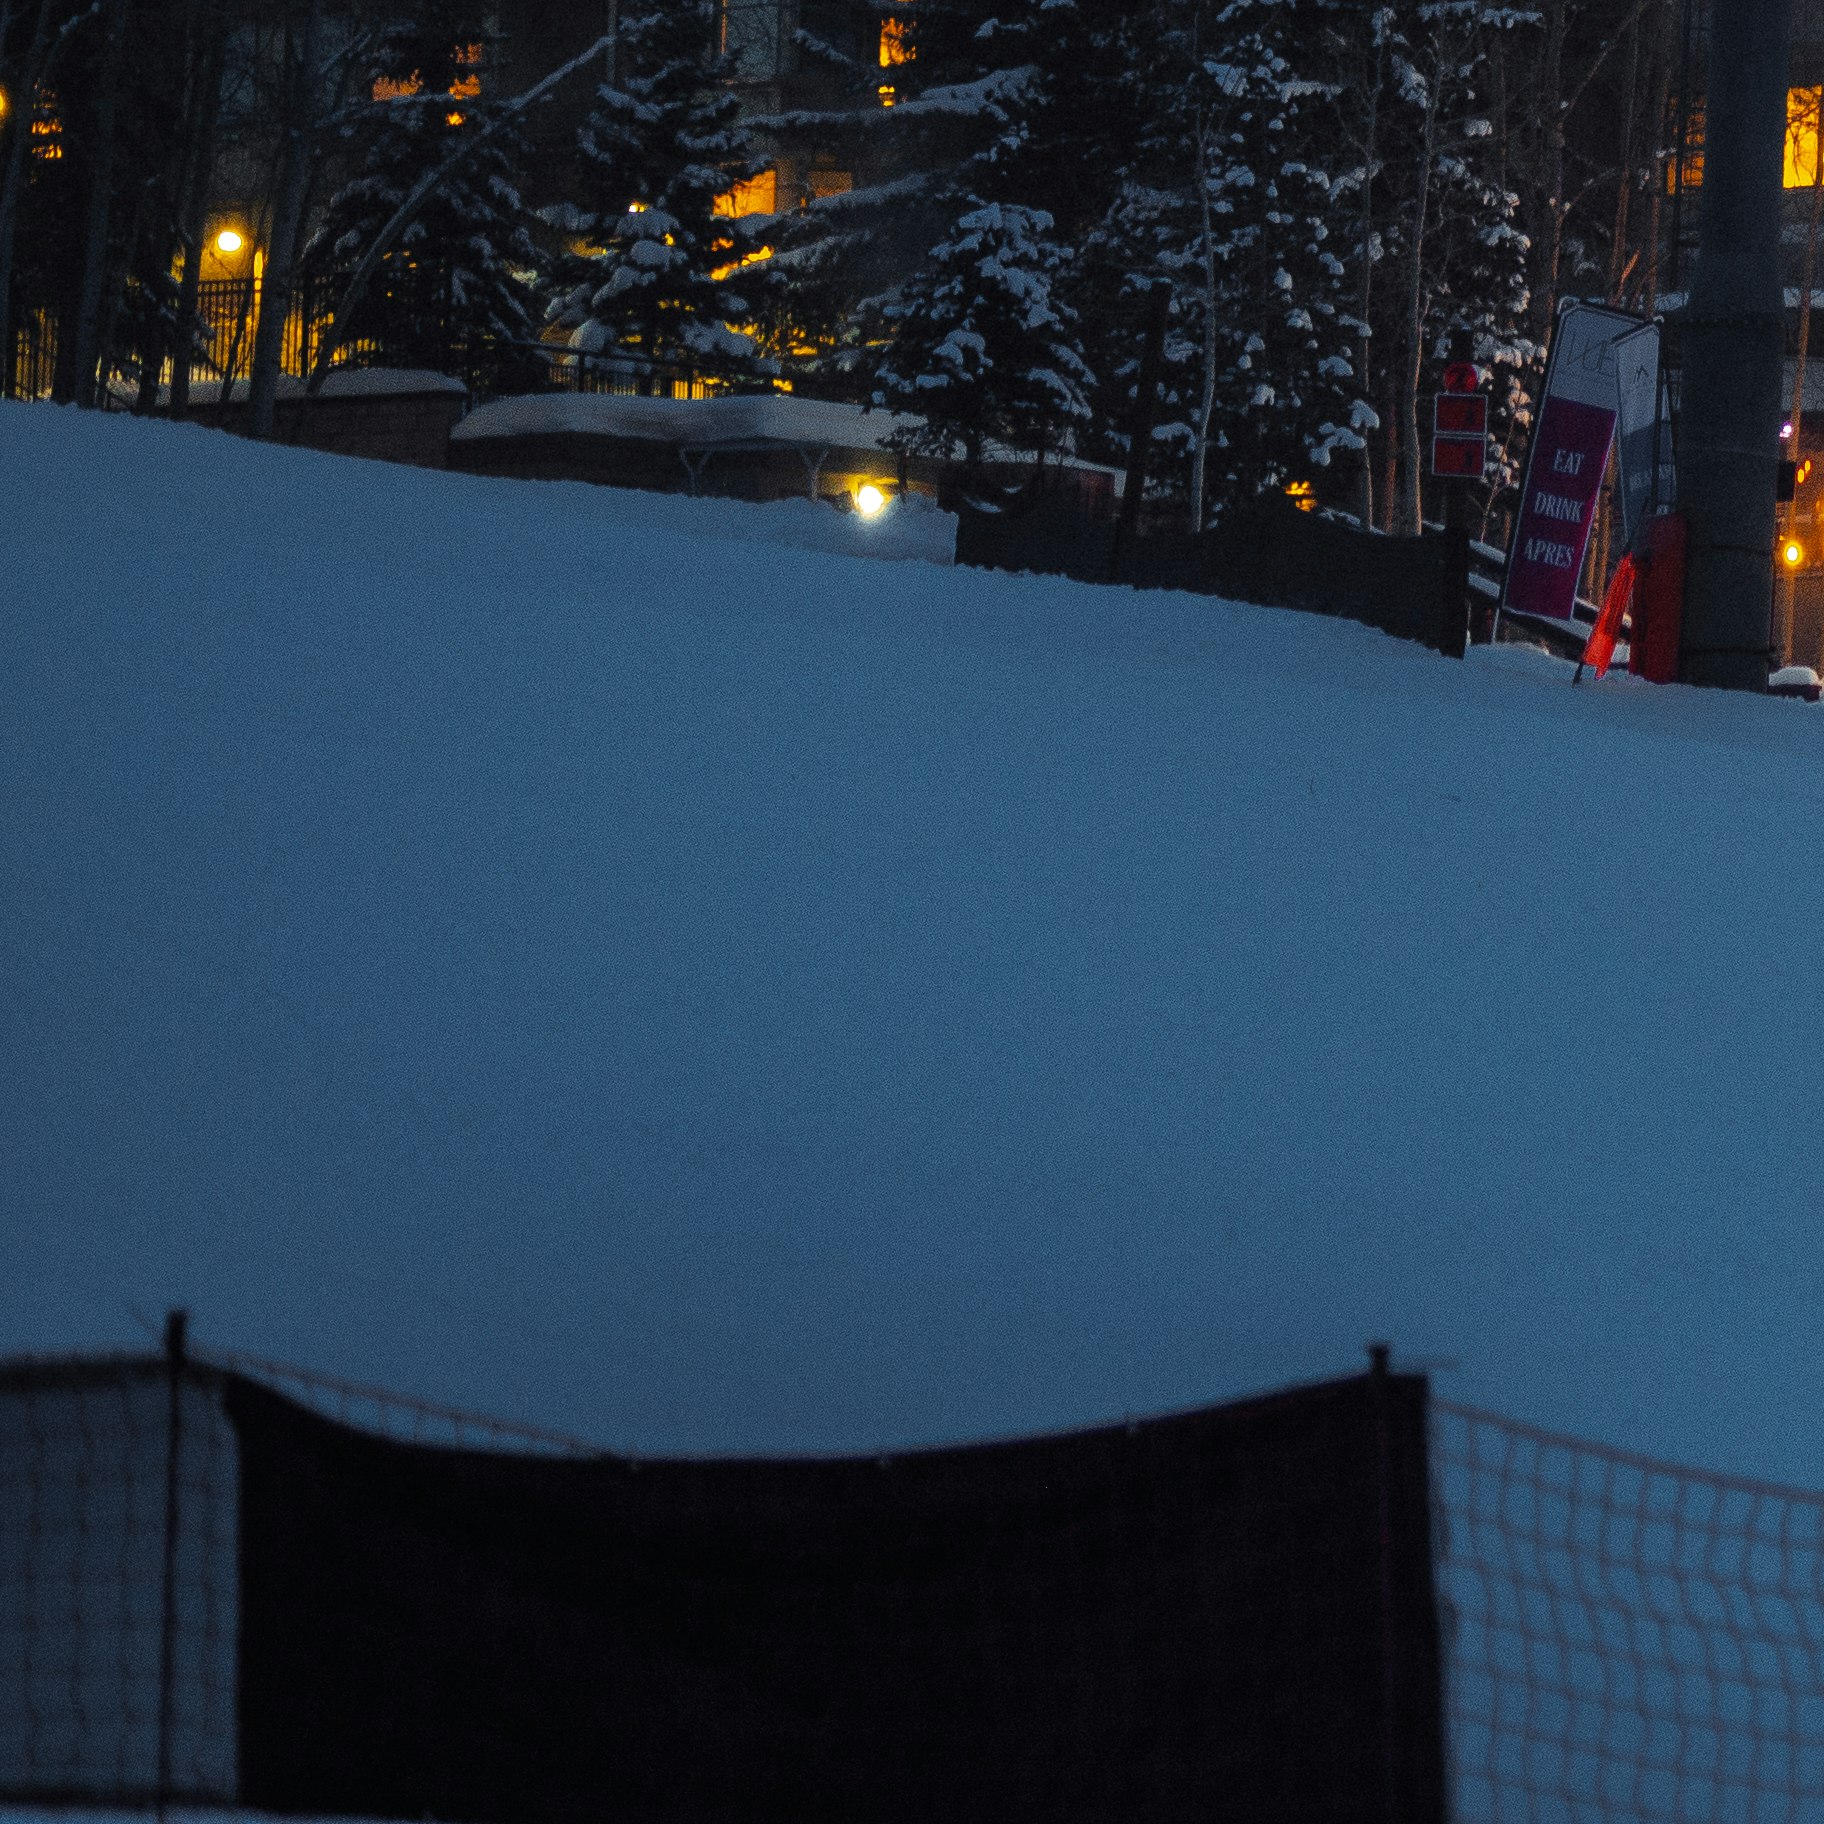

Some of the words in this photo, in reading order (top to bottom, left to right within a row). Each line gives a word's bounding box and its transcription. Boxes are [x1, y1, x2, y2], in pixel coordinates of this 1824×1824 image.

[1552, 447, 1585, 475] EAT
[1533, 491, 1585, 524] DRINK
[1523, 536, 1575, 569] APRES
